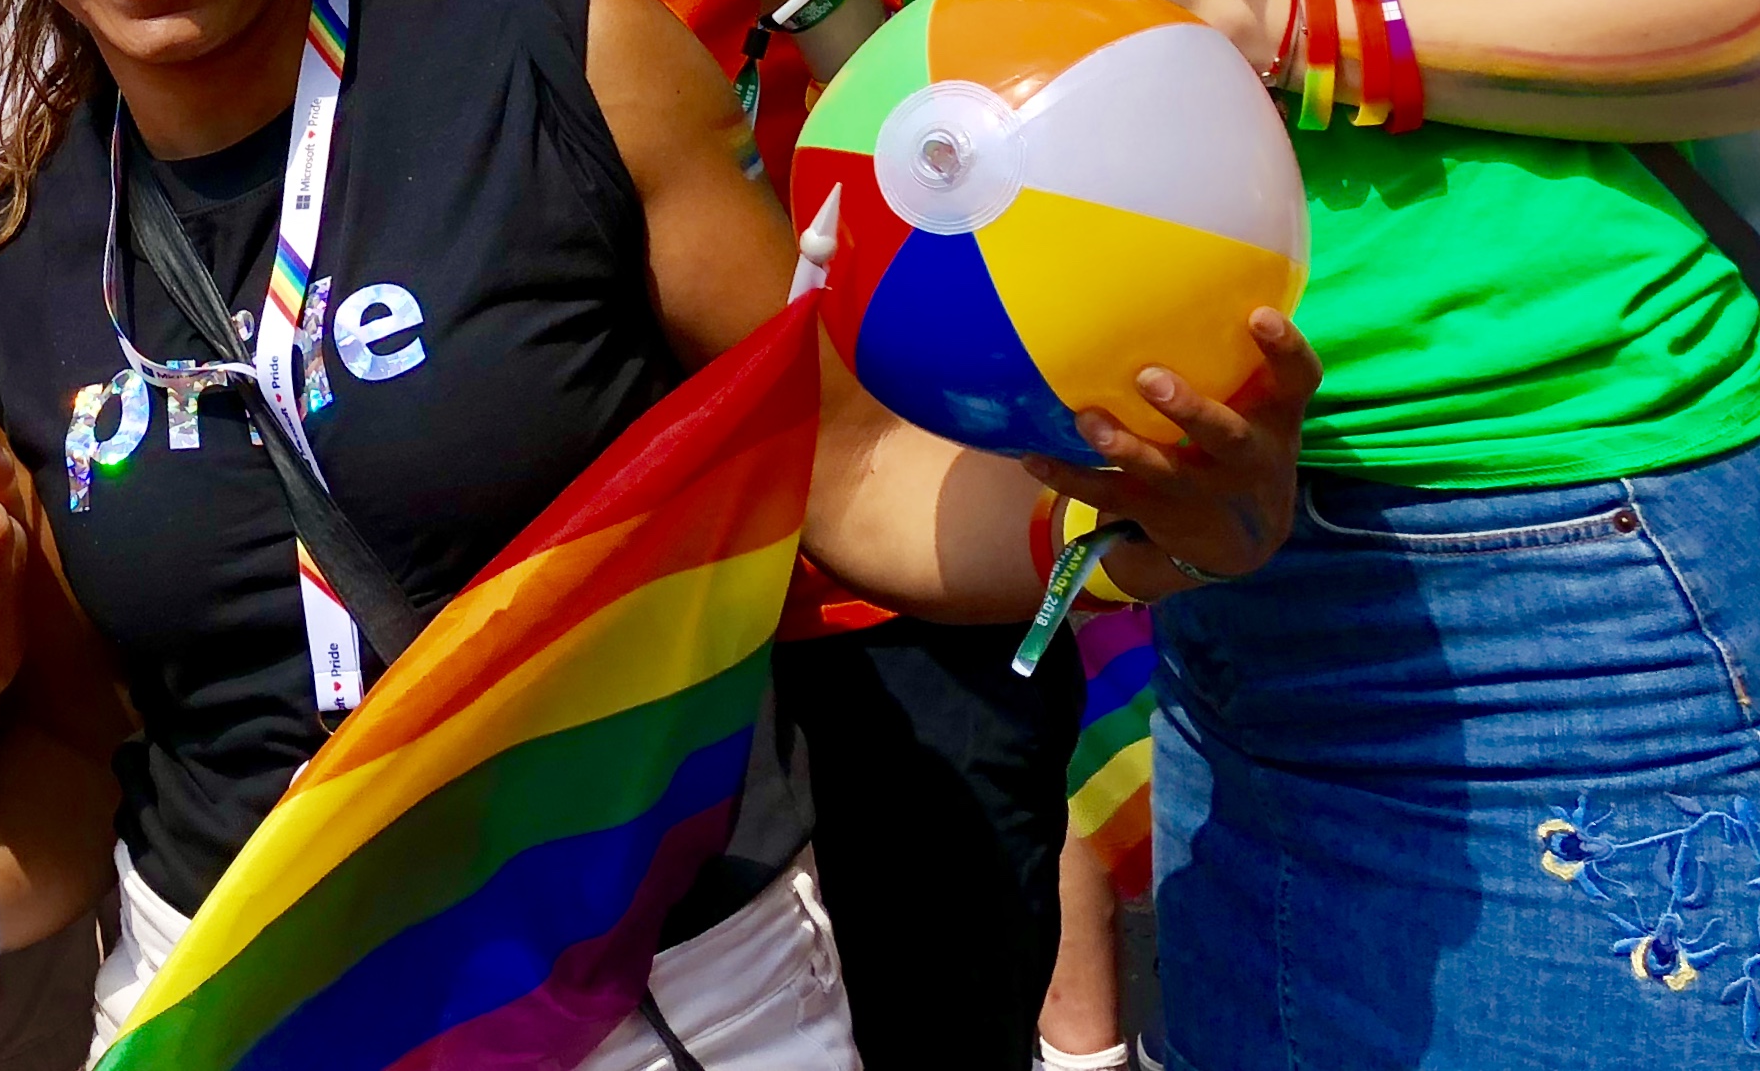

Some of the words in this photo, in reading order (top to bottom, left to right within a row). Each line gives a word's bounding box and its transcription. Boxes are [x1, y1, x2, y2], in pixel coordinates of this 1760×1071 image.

[307, 97, 322, 127] Pride
[300, 143, 315, 192] Microsoft
[271, 355, 281, 389] Pride
[1051, 545, 1087, 597] PARADE
[1036, 595, 1059, 627] 2018
[328, 643, 341, 677] Pride
